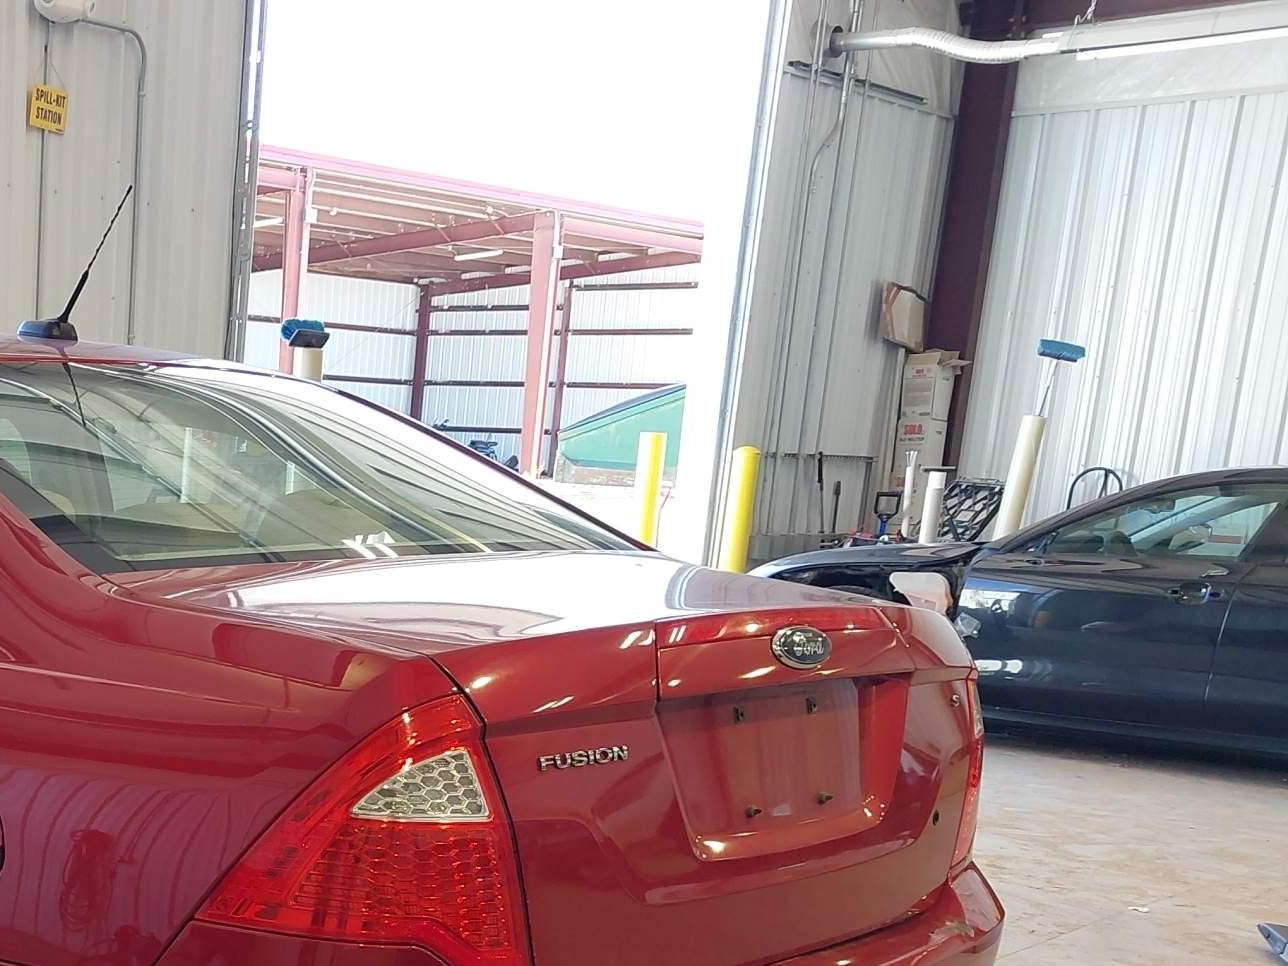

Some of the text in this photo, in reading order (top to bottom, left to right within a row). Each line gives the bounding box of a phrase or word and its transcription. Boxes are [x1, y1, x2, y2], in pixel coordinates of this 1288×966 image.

[35, 87, 66, 109] SPILL-KIT
[35, 105, 63, 126] STATION
[539, 744, 630, 771] FUSION
